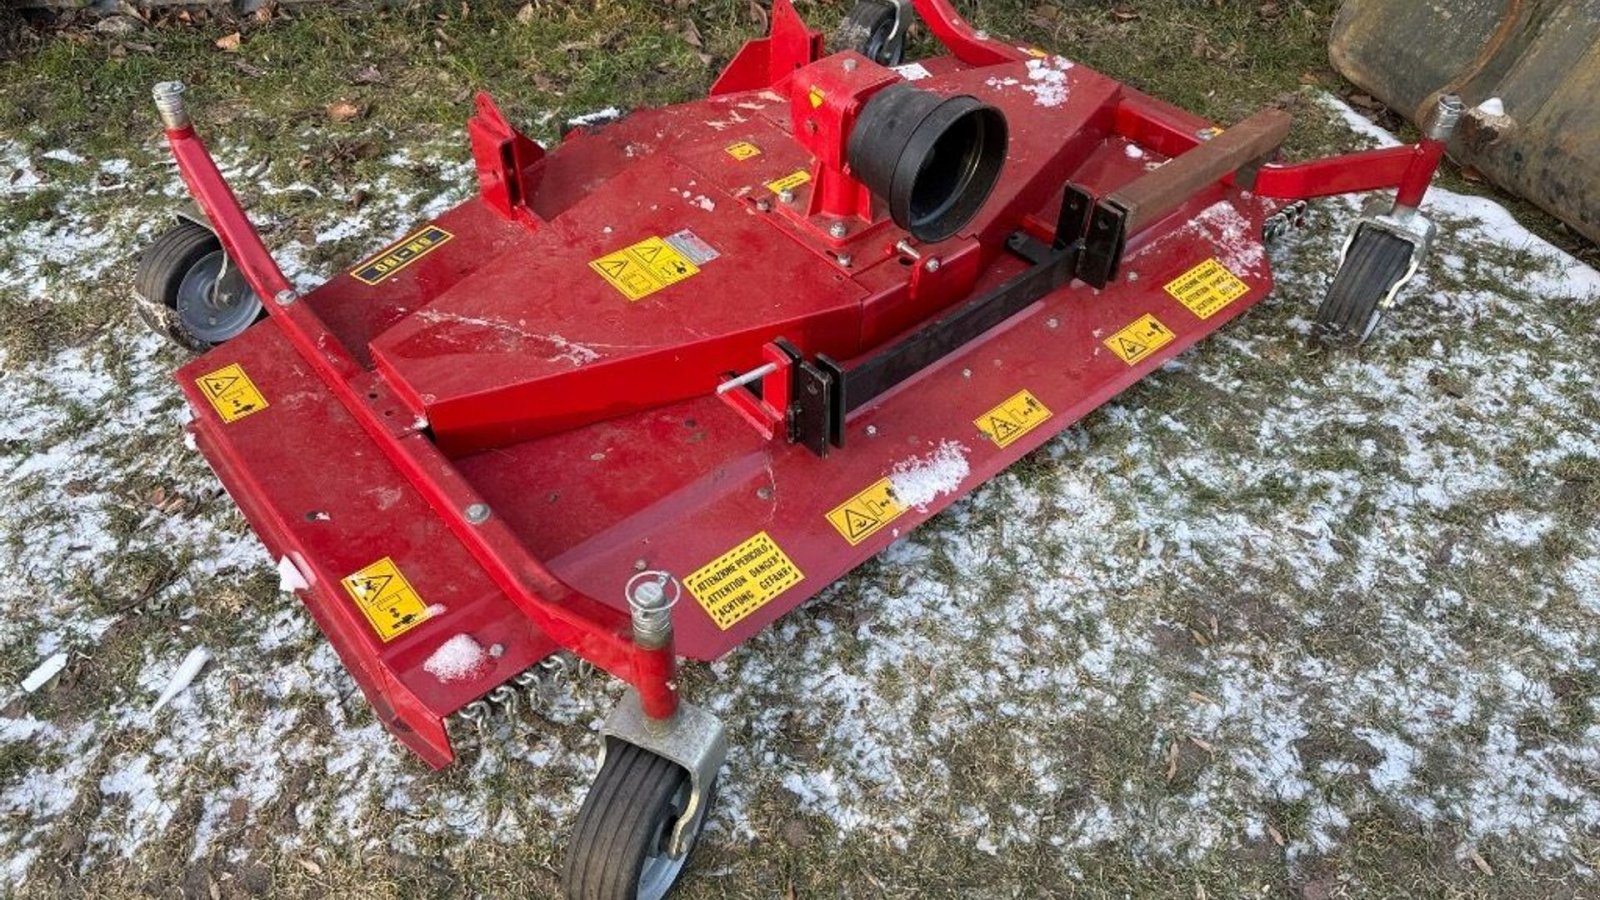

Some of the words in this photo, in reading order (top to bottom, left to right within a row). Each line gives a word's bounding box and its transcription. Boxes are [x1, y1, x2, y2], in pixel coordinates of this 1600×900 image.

[697, 563, 738, 593] ATTENZIONE
[735, 543, 769, 568] PERICOLO
[707, 575, 748, 605] ATTENTION
[749, 555, 779, 578] DANGER
[718, 590, 755, 618] ACHTUNG
[759, 567, 790, 590] GEFAHR
